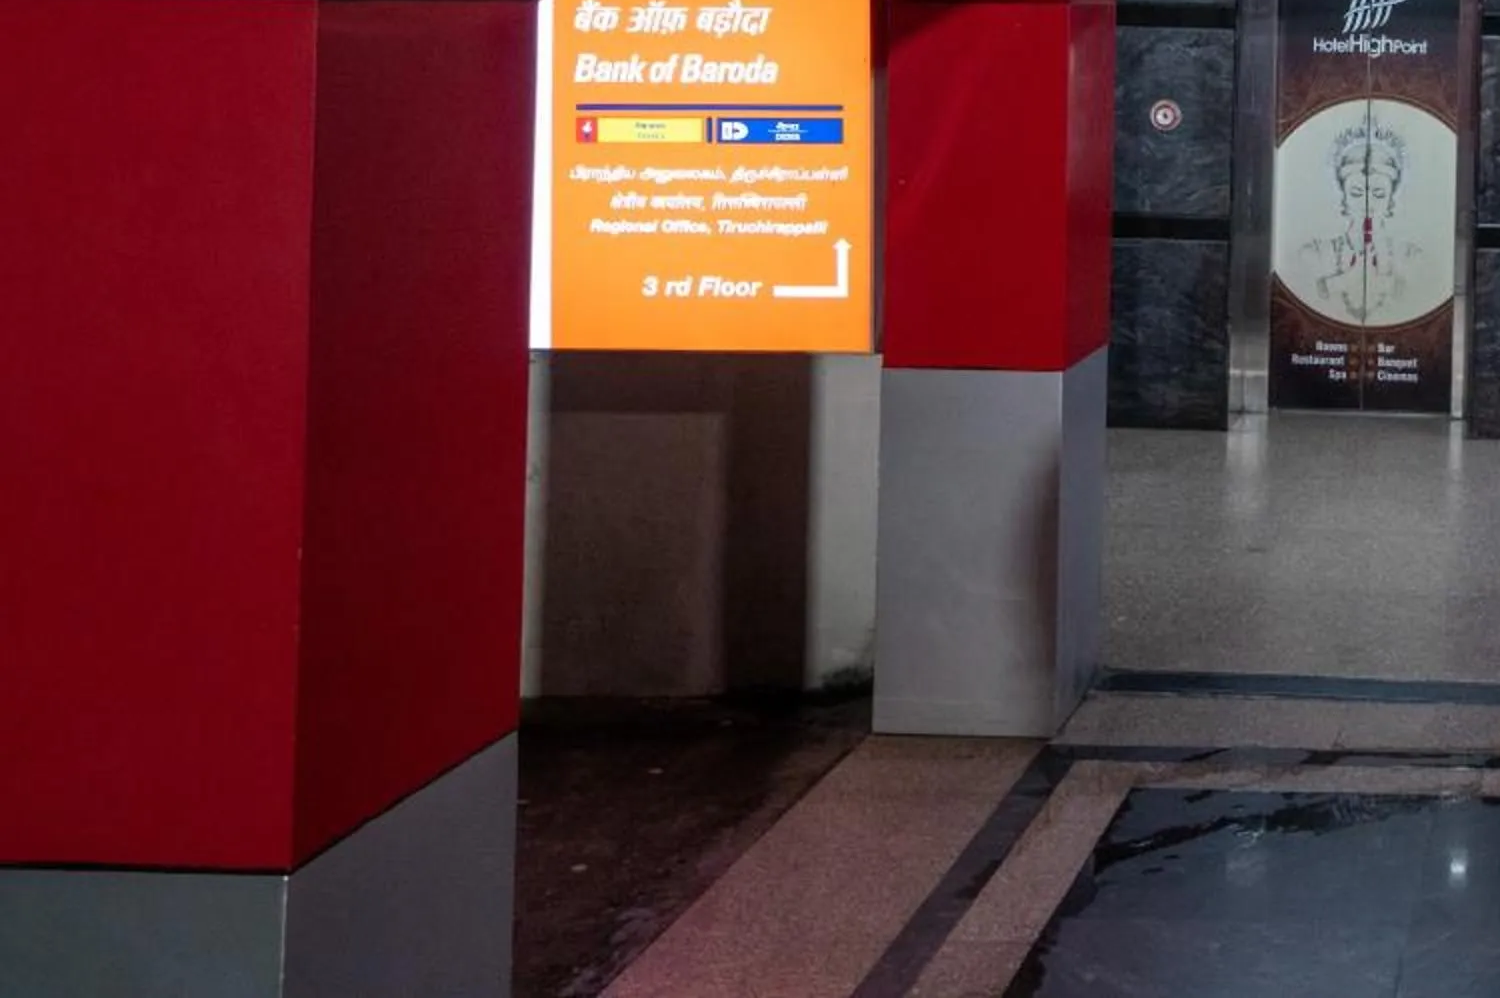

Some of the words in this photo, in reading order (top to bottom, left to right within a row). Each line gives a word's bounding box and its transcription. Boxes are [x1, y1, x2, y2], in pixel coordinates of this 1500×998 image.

[575, 53, 645, 83] Bank
[650, 53, 678, 83] of
[680, 53, 779, 84] Baroda
[591, 219, 657, 235] Regional
[642, 276, 659, 297] 3
[664, 276, 691, 297] rd
[697, 276, 762, 298] Floor
